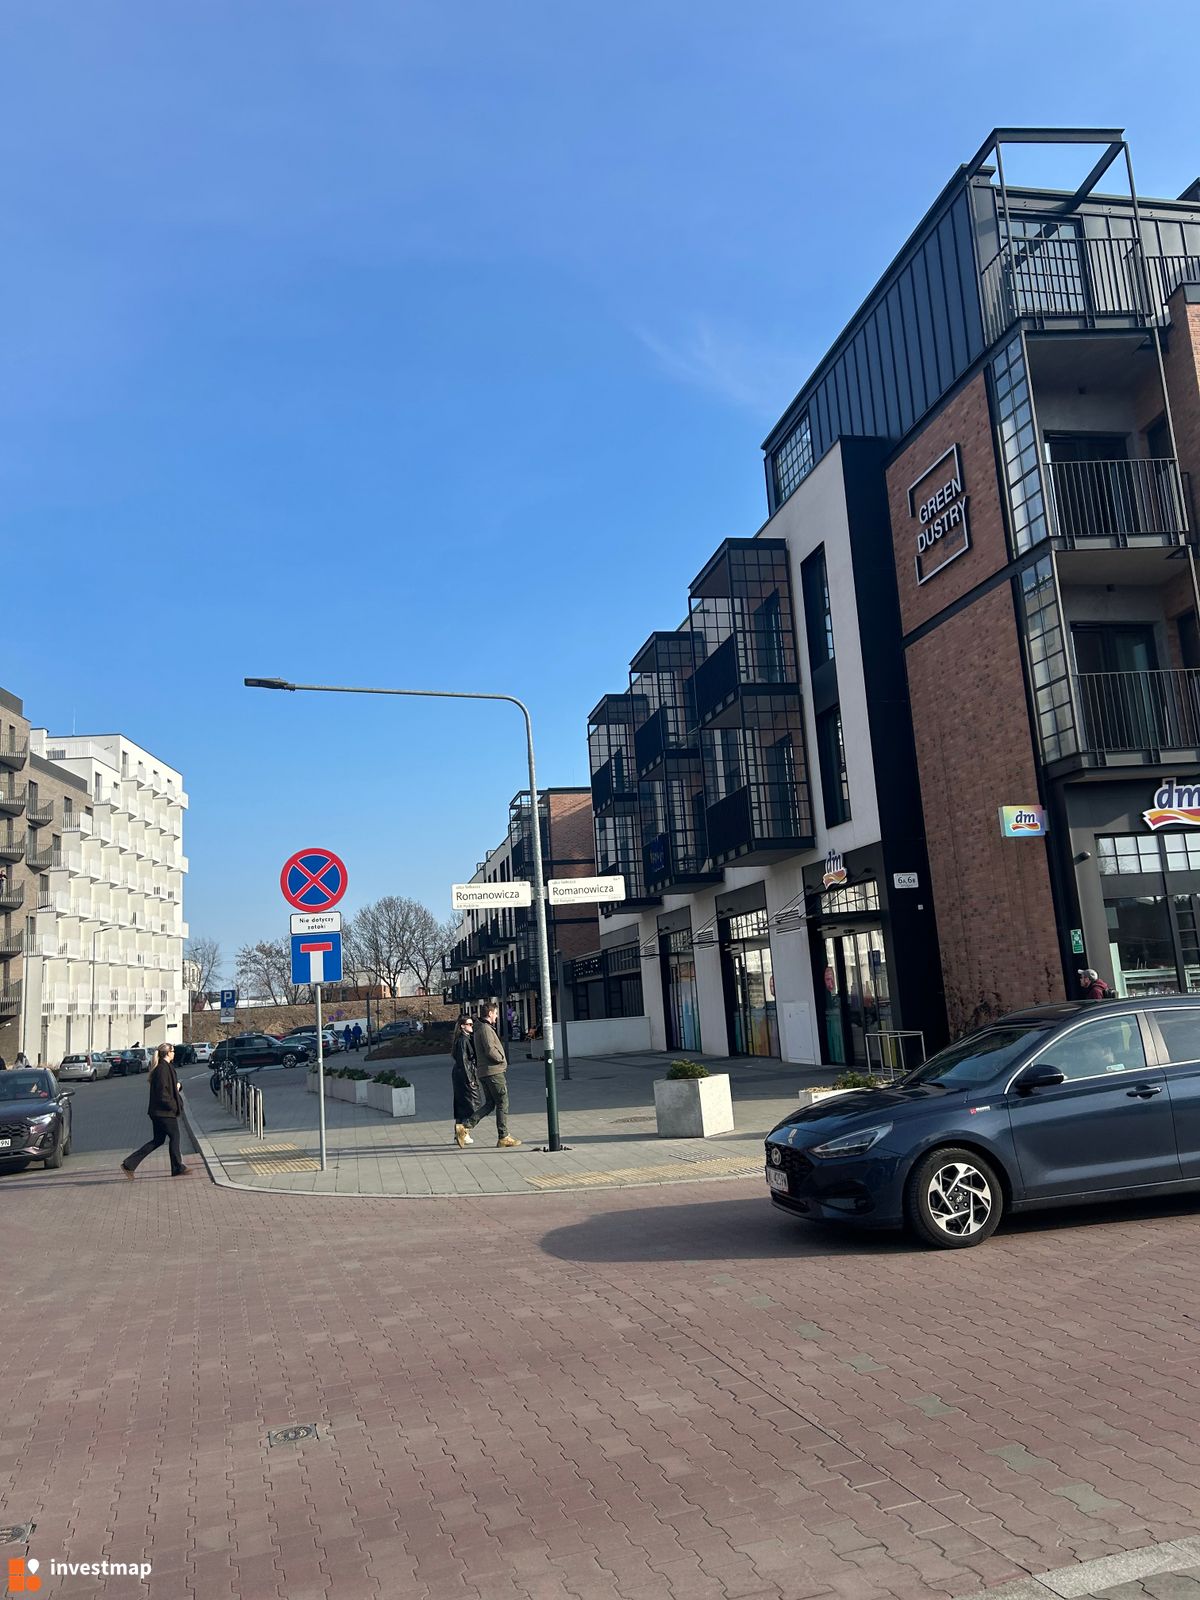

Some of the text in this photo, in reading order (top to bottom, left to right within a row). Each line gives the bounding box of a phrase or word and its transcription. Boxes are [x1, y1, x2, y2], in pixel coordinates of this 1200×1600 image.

[919, 478, 962, 524] GREEN
[917, 496, 966, 553] DUSTRY
[1157, 780, 1200, 809] dm
[1015, 810, 1035, 824] dm
[456, 890, 520, 901] Romanowicza
[552, 884, 614, 896] Romanowicza
[224, 992, 232, 1002] P
